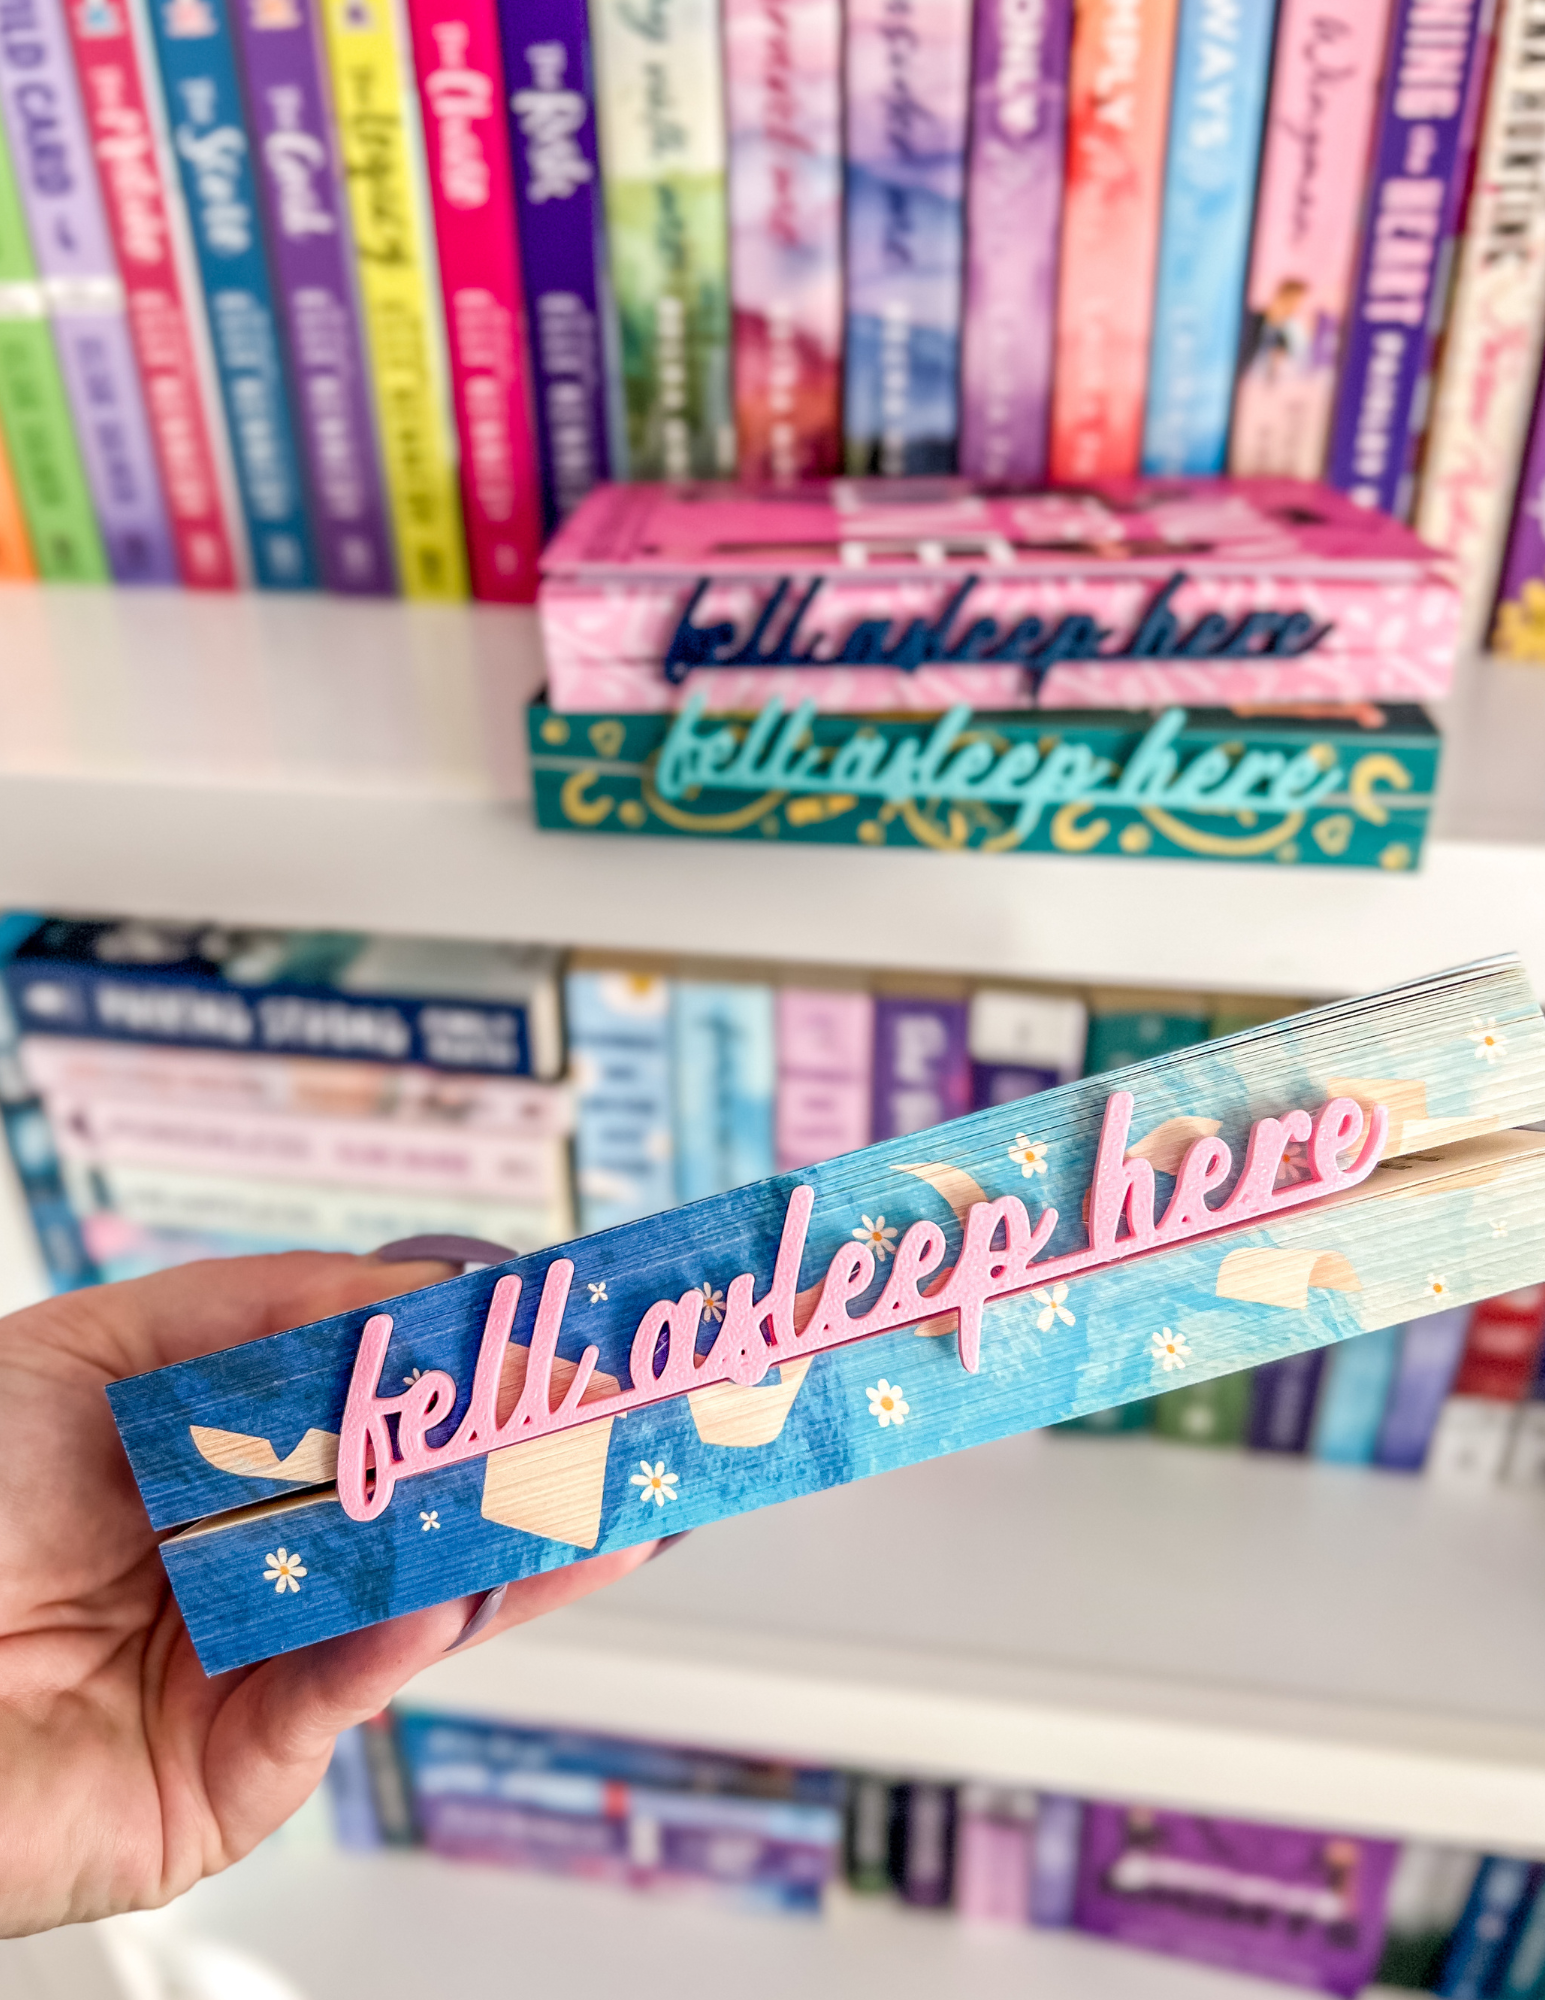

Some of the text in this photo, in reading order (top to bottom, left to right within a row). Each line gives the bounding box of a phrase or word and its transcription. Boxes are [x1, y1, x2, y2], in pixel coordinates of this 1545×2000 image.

[1189, 0, 1243, 149] WAYS
[1392, 0, 1474, 120] NING
[13, 81, 75, 197] CARD
[175, 123, 250, 255] Score
[264, 131, 335, 237] Goal
[424, 68, 494, 209] Chase
[511, 90, 594, 204] Risk
[1362, 176, 1446, 327] HEART
[664, 571, 1337, 699] fell asleep here
[655, 692, 1344, 838] fell asleep here
[338, 1090, 1390, 1523] fell asleep here
